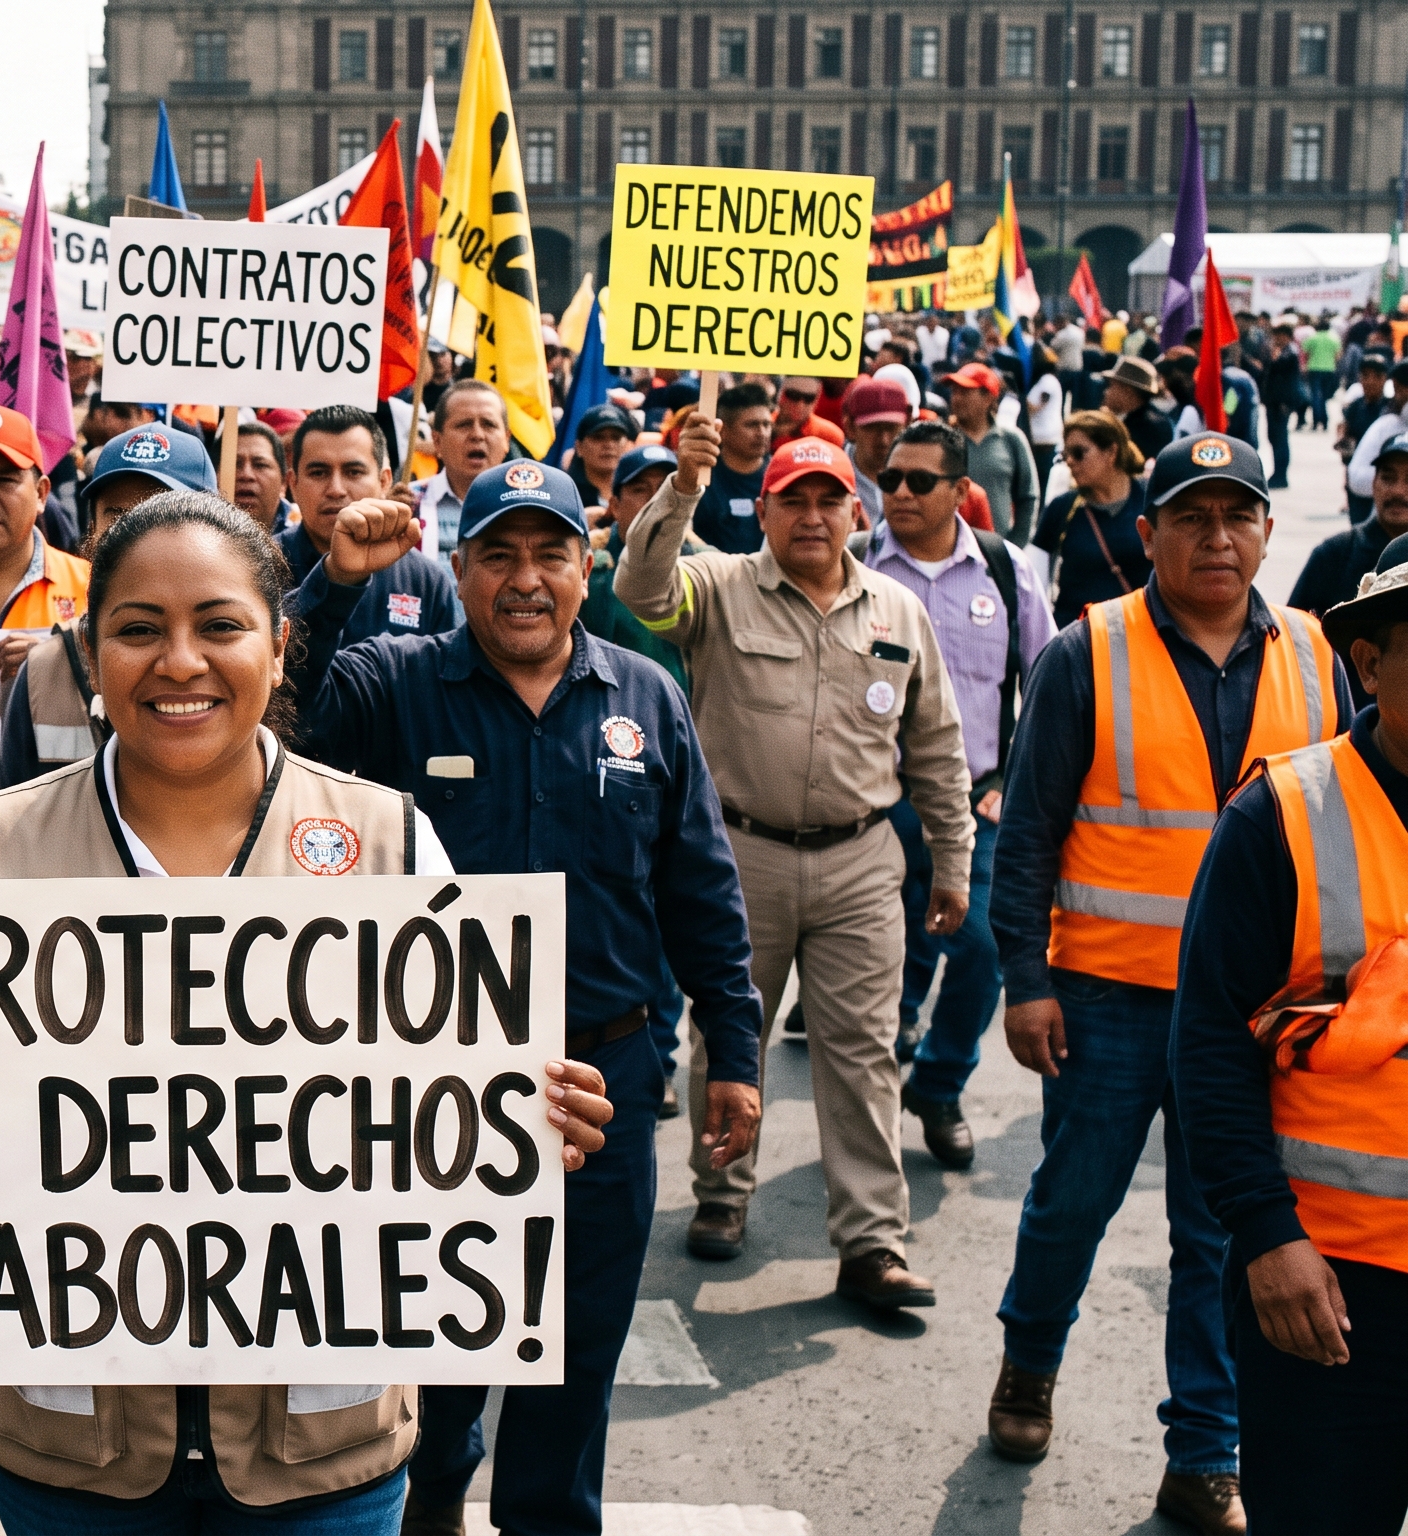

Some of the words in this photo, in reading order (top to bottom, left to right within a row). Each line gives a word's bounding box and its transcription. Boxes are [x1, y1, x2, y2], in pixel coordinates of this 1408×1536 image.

[627, 183, 862, 239] DEFENDEMOS
[119, 244, 375, 305] CONTRATOS
[649, 242, 839, 296] NUESTROS
[113, 314, 371, 373] COLECTIVOS
[633, 303, 852, 361] DERECHOS
[39, 1072, 539, 1196] DERECHOS
